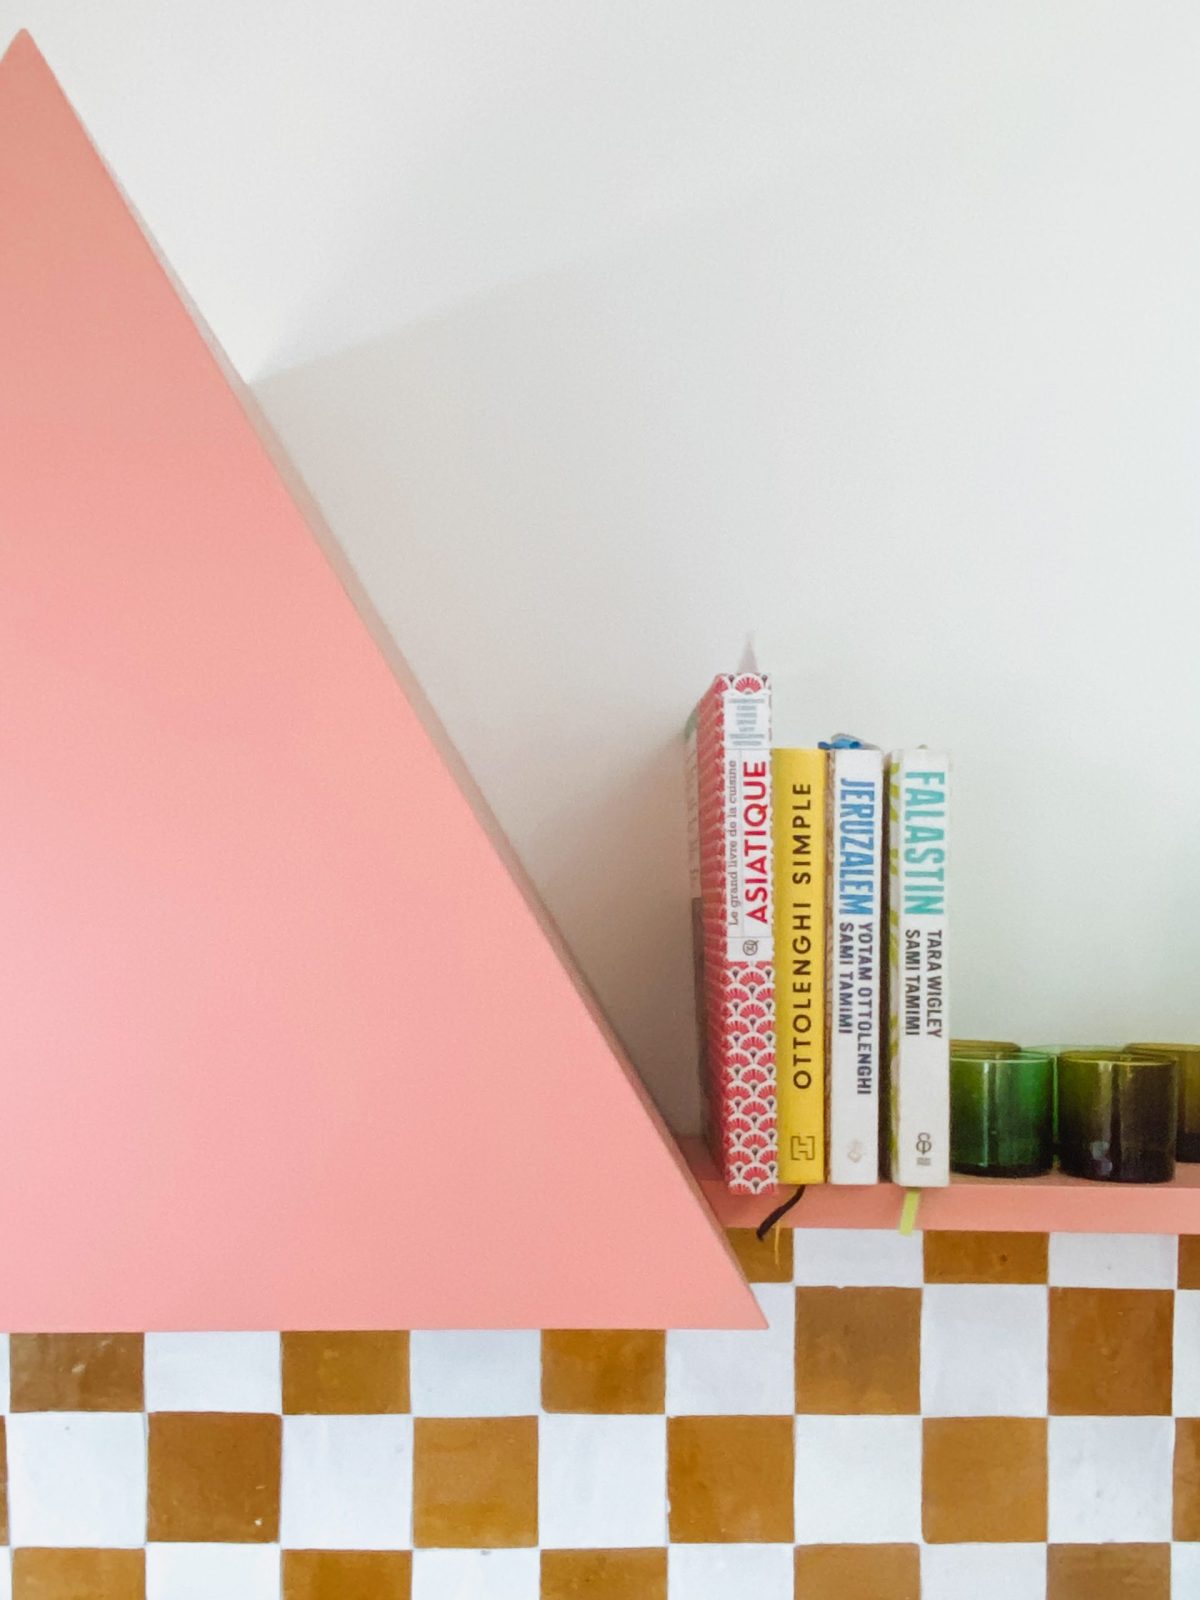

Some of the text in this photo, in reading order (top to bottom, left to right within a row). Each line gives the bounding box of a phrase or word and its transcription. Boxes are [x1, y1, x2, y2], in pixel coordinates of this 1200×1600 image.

[727, 760, 740, 926] Le grand livre de la cuisine
[743, 761, 769, 924] ASIATIQUE
[839, 778, 875, 916] JERUZALEM
[904, 771, 945, 916] FALASTIN
[793, 783, 812, 1090] OTTOLENGHI SIMPLE
[838, 923, 854, 1035] SAMI TAMIMI
[857, 922, 873, 1095] YOTAM OTTOLENGHI
[905, 930, 921, 1036] SAMI TAMIMI
[926, 929, 943, 1039] TARA WIGLEY
